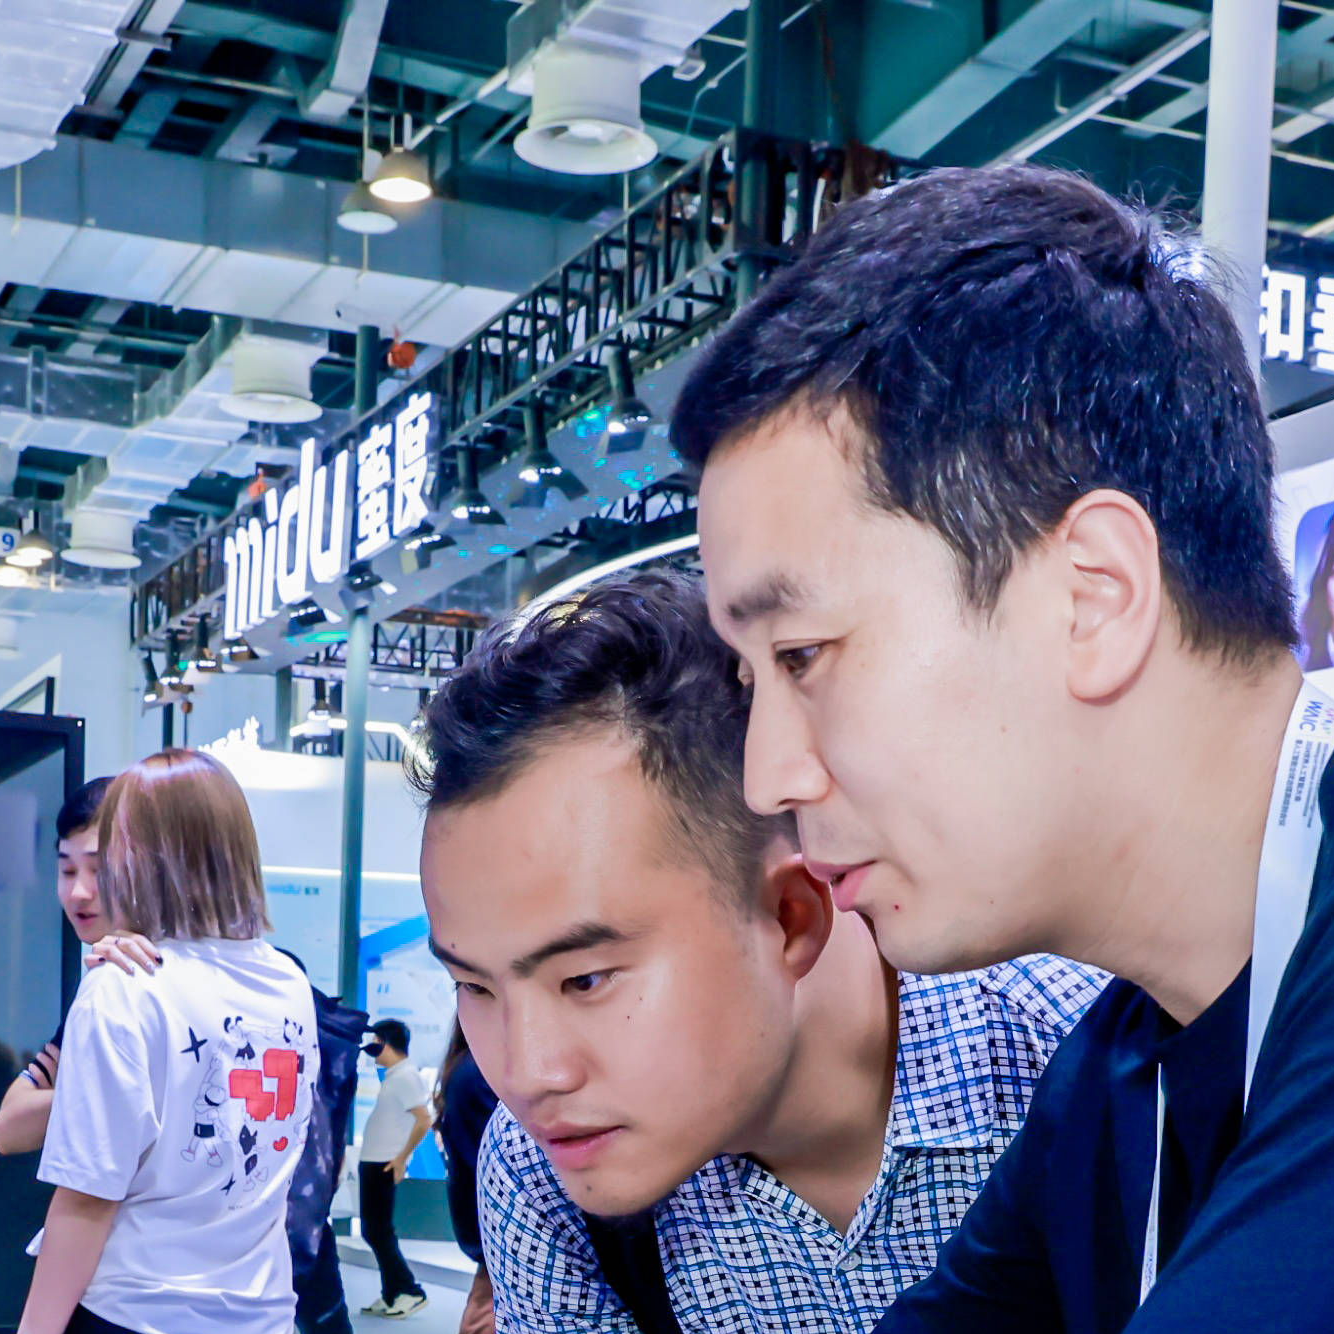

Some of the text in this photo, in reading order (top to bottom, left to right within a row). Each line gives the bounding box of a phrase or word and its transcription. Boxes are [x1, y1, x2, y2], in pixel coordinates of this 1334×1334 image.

[224, 392, 432, 640] midu 蜜度
[1300, 700, 1324, 731] WAIC
